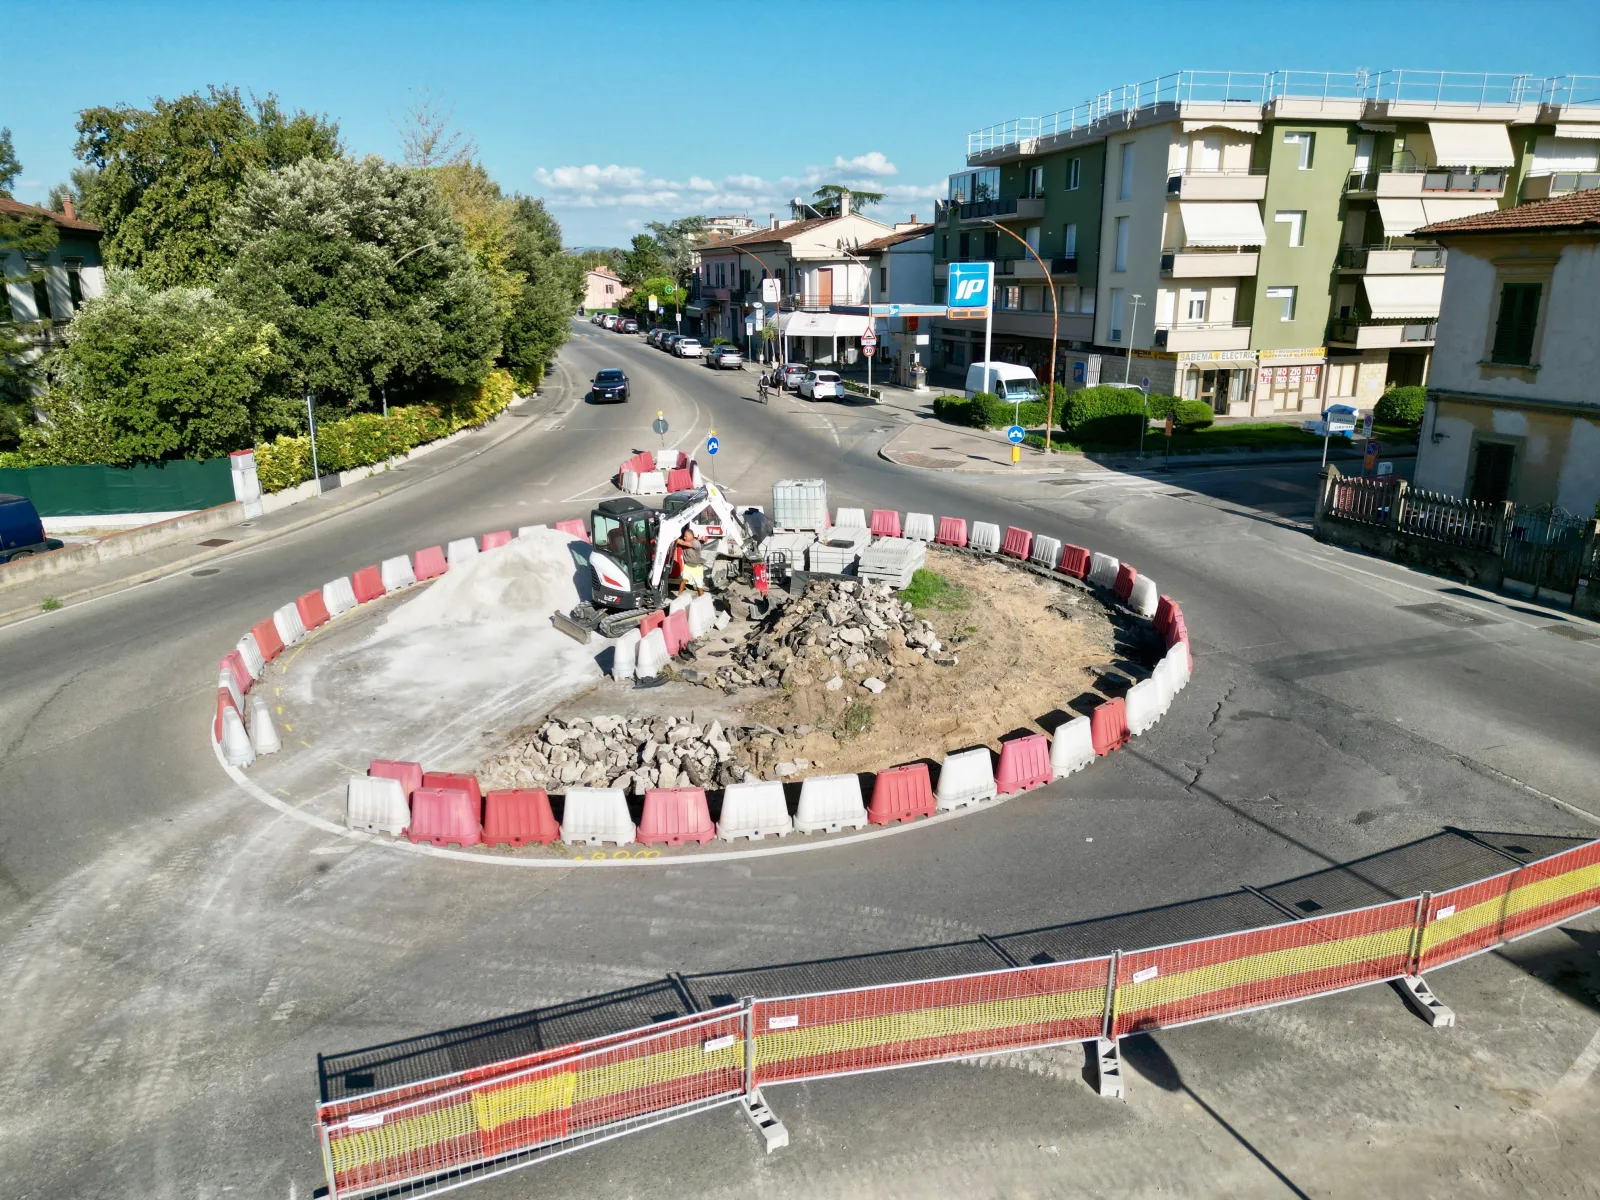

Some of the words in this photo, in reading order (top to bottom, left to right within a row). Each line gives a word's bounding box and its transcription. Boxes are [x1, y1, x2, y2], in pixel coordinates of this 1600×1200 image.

[955, 279, 985, 300] IP
[1180, 352, 1213, 361] SABEMA
[1221, 351, 1255, 360] ELECTRIC
